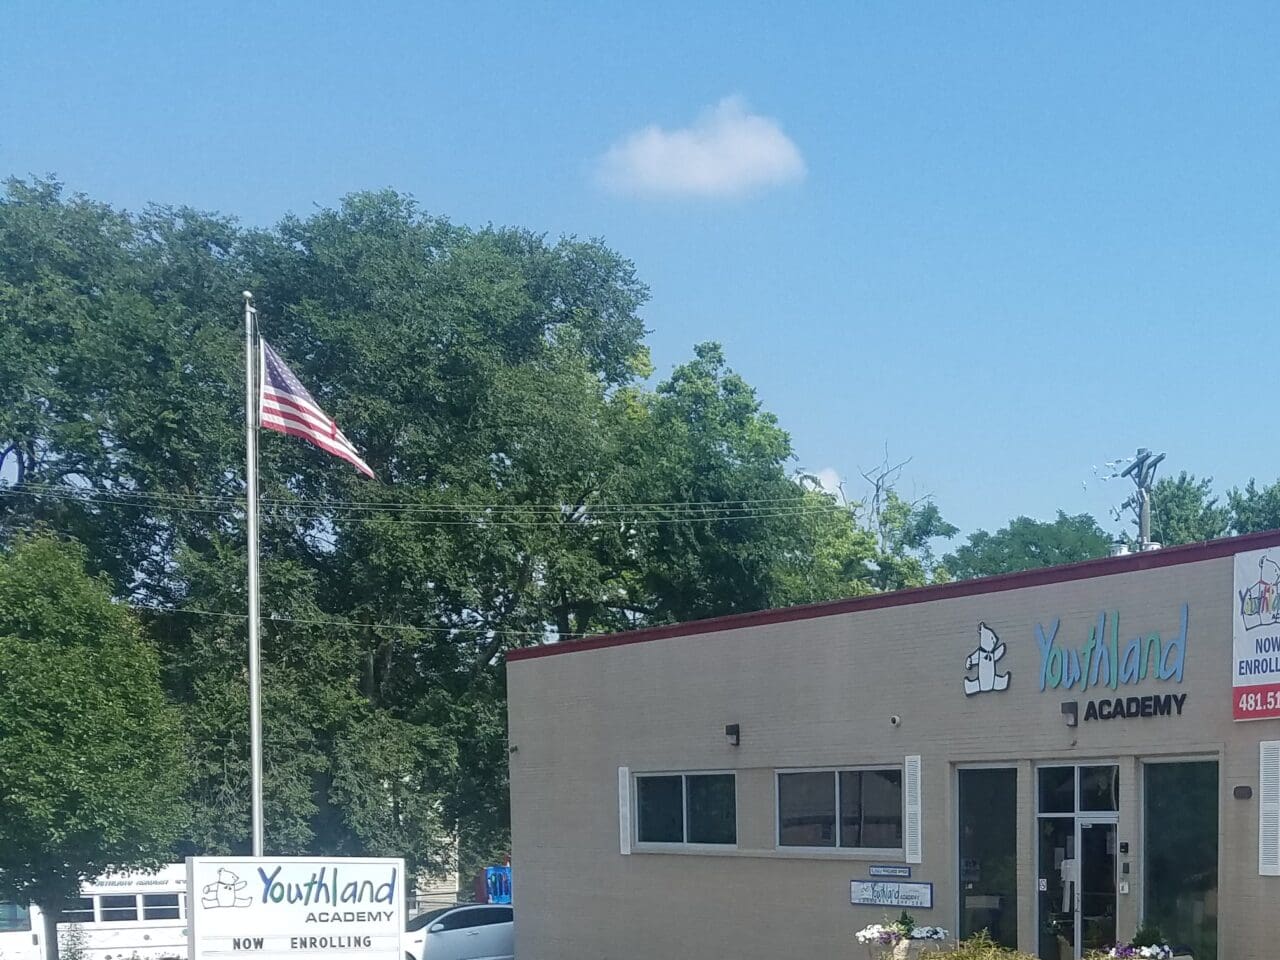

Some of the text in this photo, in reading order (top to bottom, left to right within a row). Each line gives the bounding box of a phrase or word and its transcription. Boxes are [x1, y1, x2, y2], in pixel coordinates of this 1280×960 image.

[1034, 601, 1189, 693] Youthland
[1083, 693, 1187, 721] ACADEMY
[257, 865, 397, 907] Youthland
[305, 911, 394, 924] ACADEMY
[232, 936, 372, 950] NOW ENROLLING
